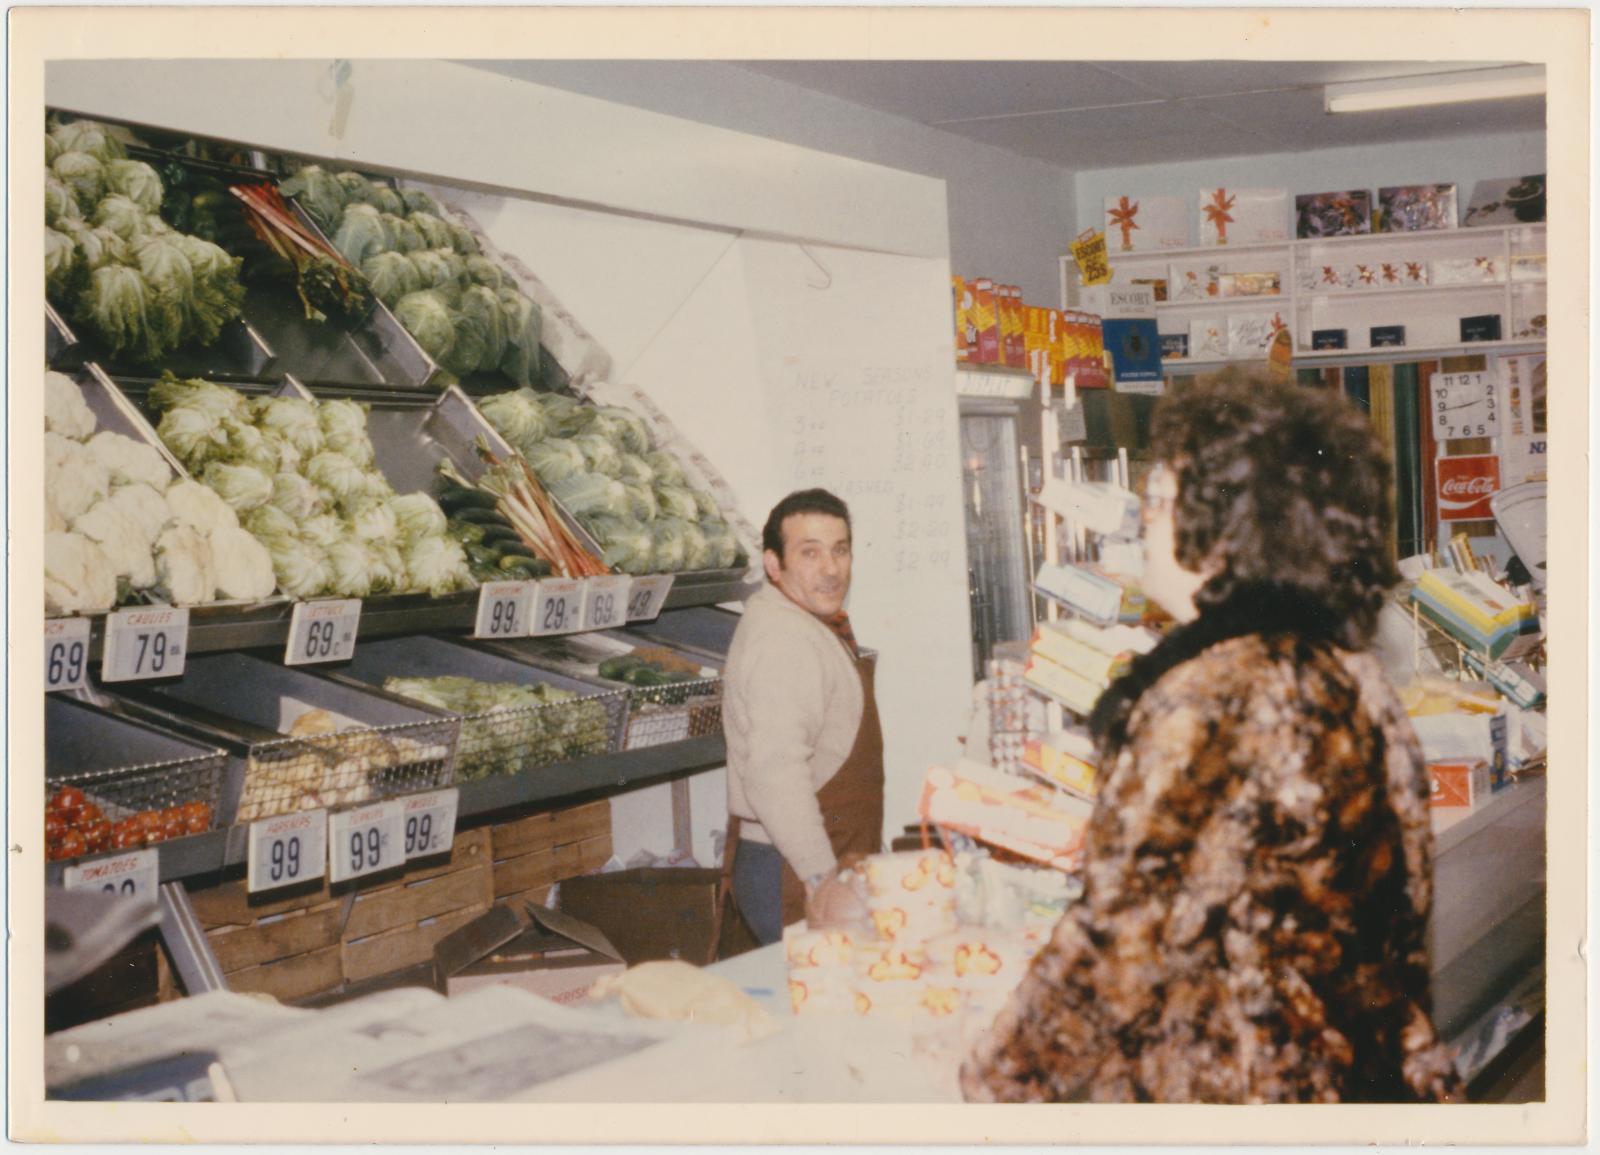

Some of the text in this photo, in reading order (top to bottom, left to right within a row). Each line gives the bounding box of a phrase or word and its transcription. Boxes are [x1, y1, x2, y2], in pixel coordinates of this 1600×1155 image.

[1110, 293, 1150, 306] ESCORT
[794, 370, 838, 392] NEW
[1444, 375, 1481, 386] 11 12 1
[1435, 389, 1448, 398] 10
[1486, 385, 1494, 395] 2
[828, 388, 918, 408] POTATOES
[1487, 399, 1495, 409] 3
[1438, 402, 1446, 412] 9
[1439, 415, 1447, 425] 8
[1488, 412, 1496, 422] 4
[792, 415, 806, 435] 3
[1447, 425, 1486, 436] 7 6 5
[1442, 476, 1494, 495] Coca-Cola
[127, 611, 173, 625] CAULIES
[135, 631, 167, 674] 79
[48, 642, 84, 684] 69
[270, 836, 300, 881] 99
[81, 857, 137, 880] TOMATOES
